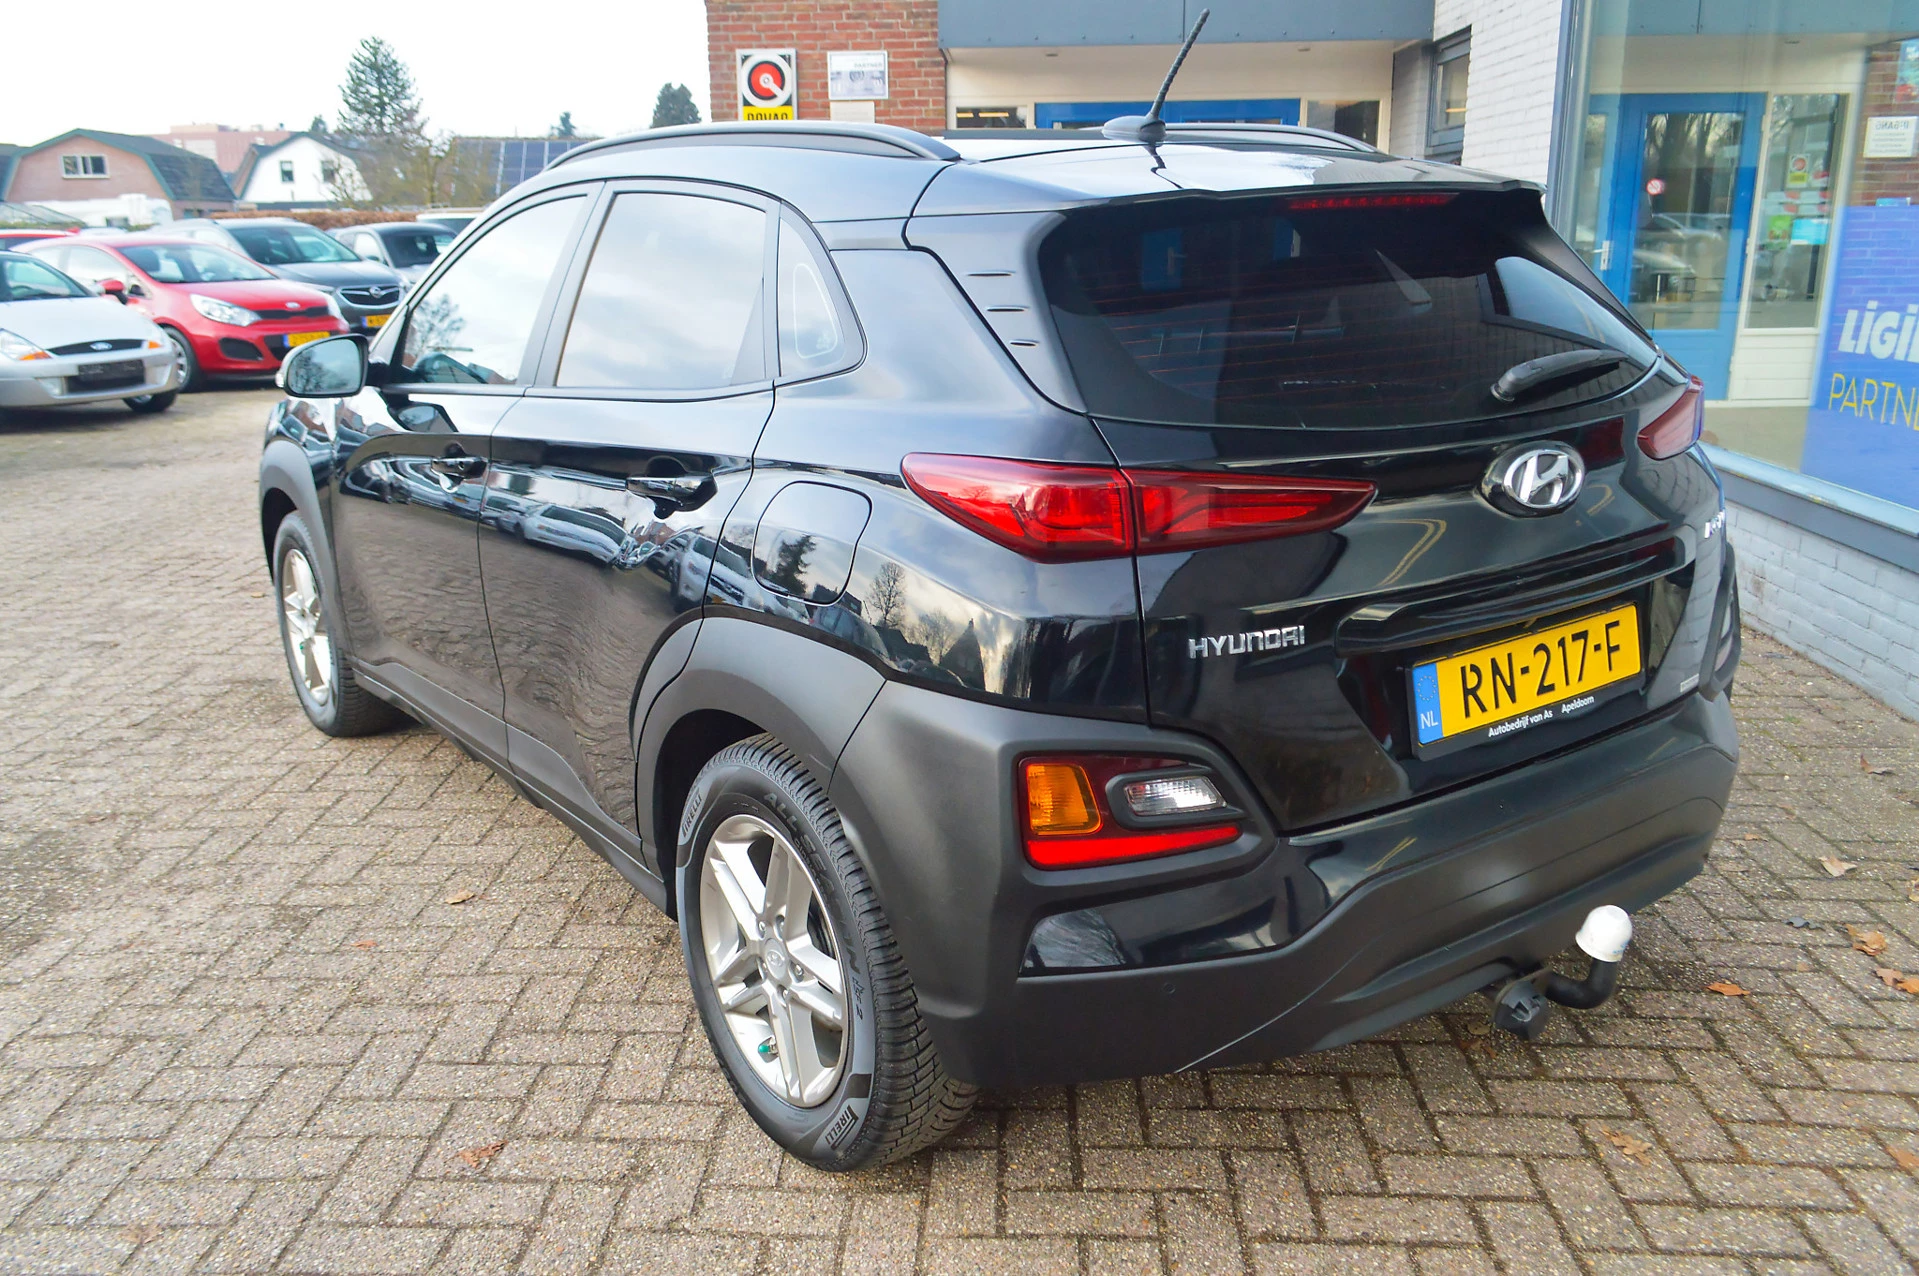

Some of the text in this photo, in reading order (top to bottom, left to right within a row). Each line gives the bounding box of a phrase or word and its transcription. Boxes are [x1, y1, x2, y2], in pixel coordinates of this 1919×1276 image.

[1188, 625, 1305, 659] HYUNDAI
[1460, 620, 1620, 718] RN-217-F
[1420, 711, 1438, 730] NL
[1488, 695, 1595, 737] Autobedrijf van As Apeldoorn
[825, 1104, 859, 1151] PIRELLI
